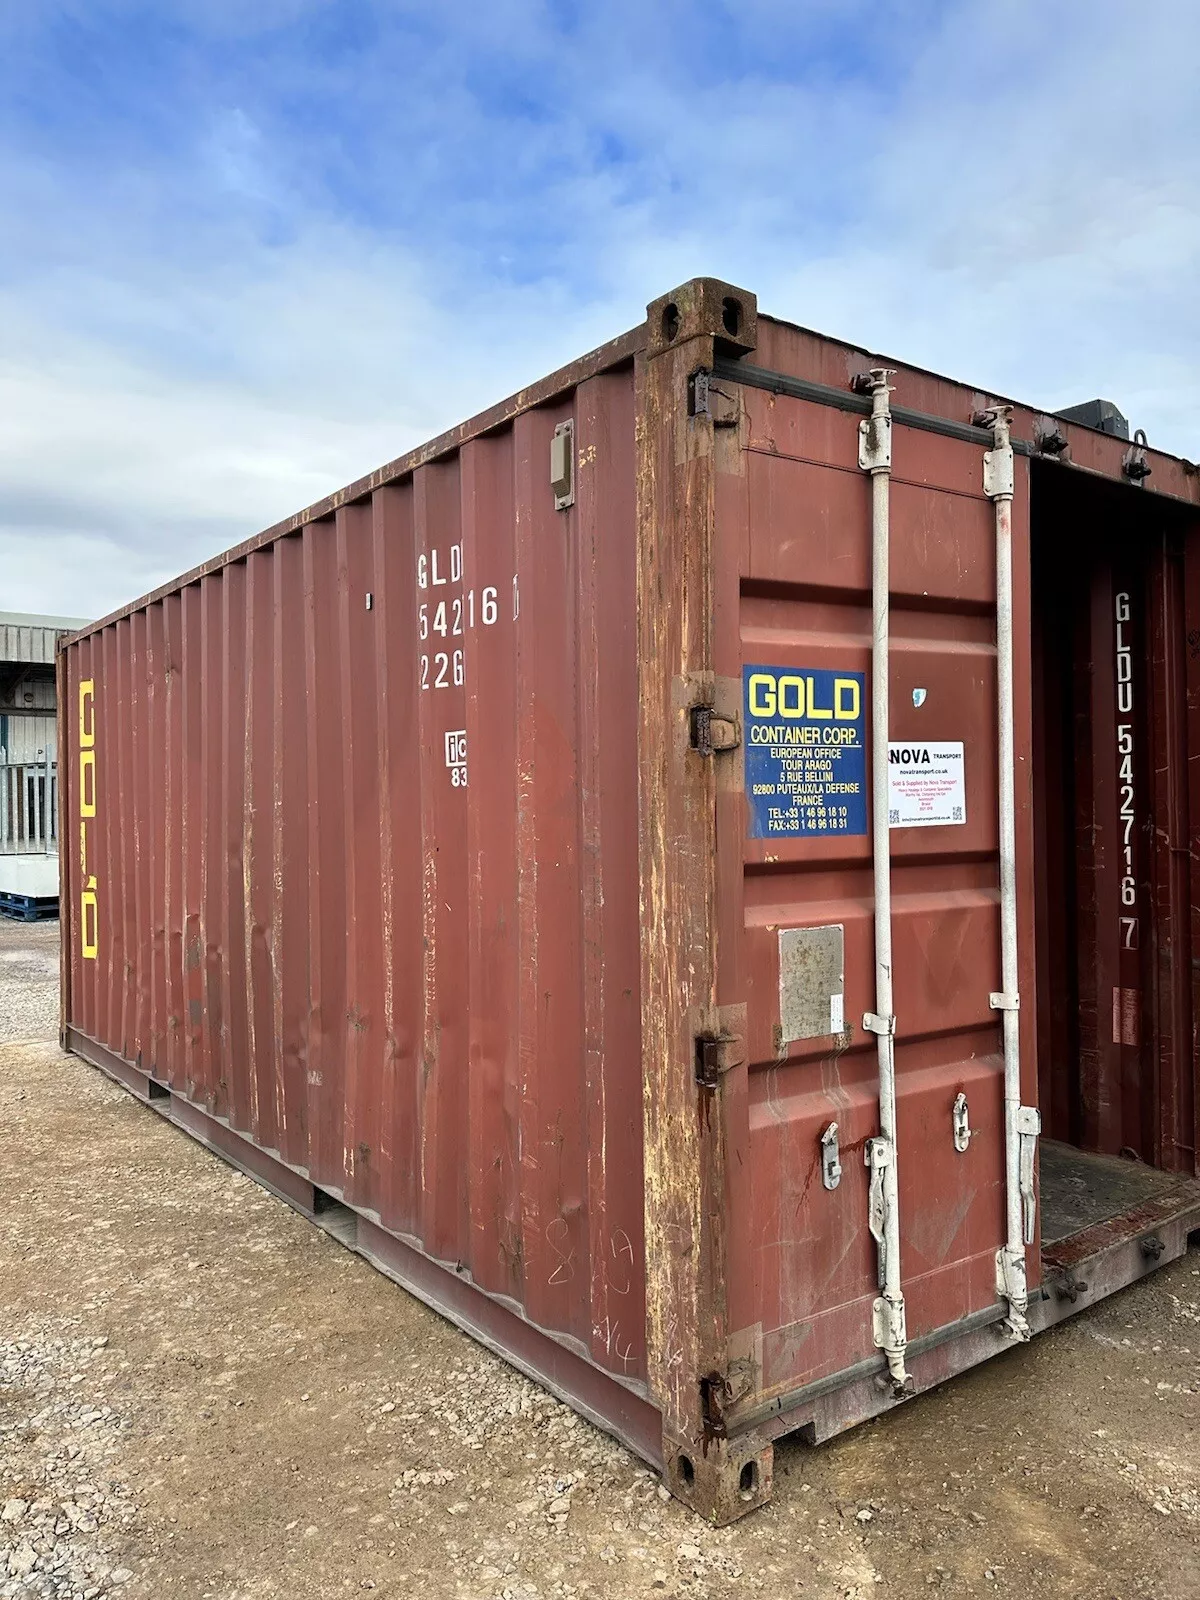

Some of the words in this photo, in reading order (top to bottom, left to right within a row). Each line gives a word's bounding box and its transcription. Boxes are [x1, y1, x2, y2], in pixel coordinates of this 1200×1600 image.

[418, 538, 464, 589] GLD
[419, 586, 498, 640] 54216
[1115, 592, 1132, 712] GLDU
[421, 649, 466, 690] 22G
[748, 673, 860, 720] GOLD
[750, 725, 821, 744] CONTAINER
[822, 726, 860, 745] CORP.
[770, 748, 812, 759] EUROPEAN
[814, 748, 842, 759] OFFICE
[890, 749, 930, 764] NOVA
[781, 760, 803, 771] TOUR
[804, 760, 832, 771] ARAGO
[451, 767, 468, 787] 83
[780, 772, 786, 782] 5
[787, 772, 804, 782] RUE
[804, 771, 834, 782] BELLINI
[752, 784, 776, 795] 92800
[825, 782, 860, 793] DEFENSE
[792, 795, 823, 806] FRANCE
[806, 807, 816, 817] 46
[828, 806, 837, 817] 18
[838, 806, 848, 817] 10
[807, 819, 817, 830] 46
[829, 819, 837, 830] 18
[838, 819, 848, 829] 31
